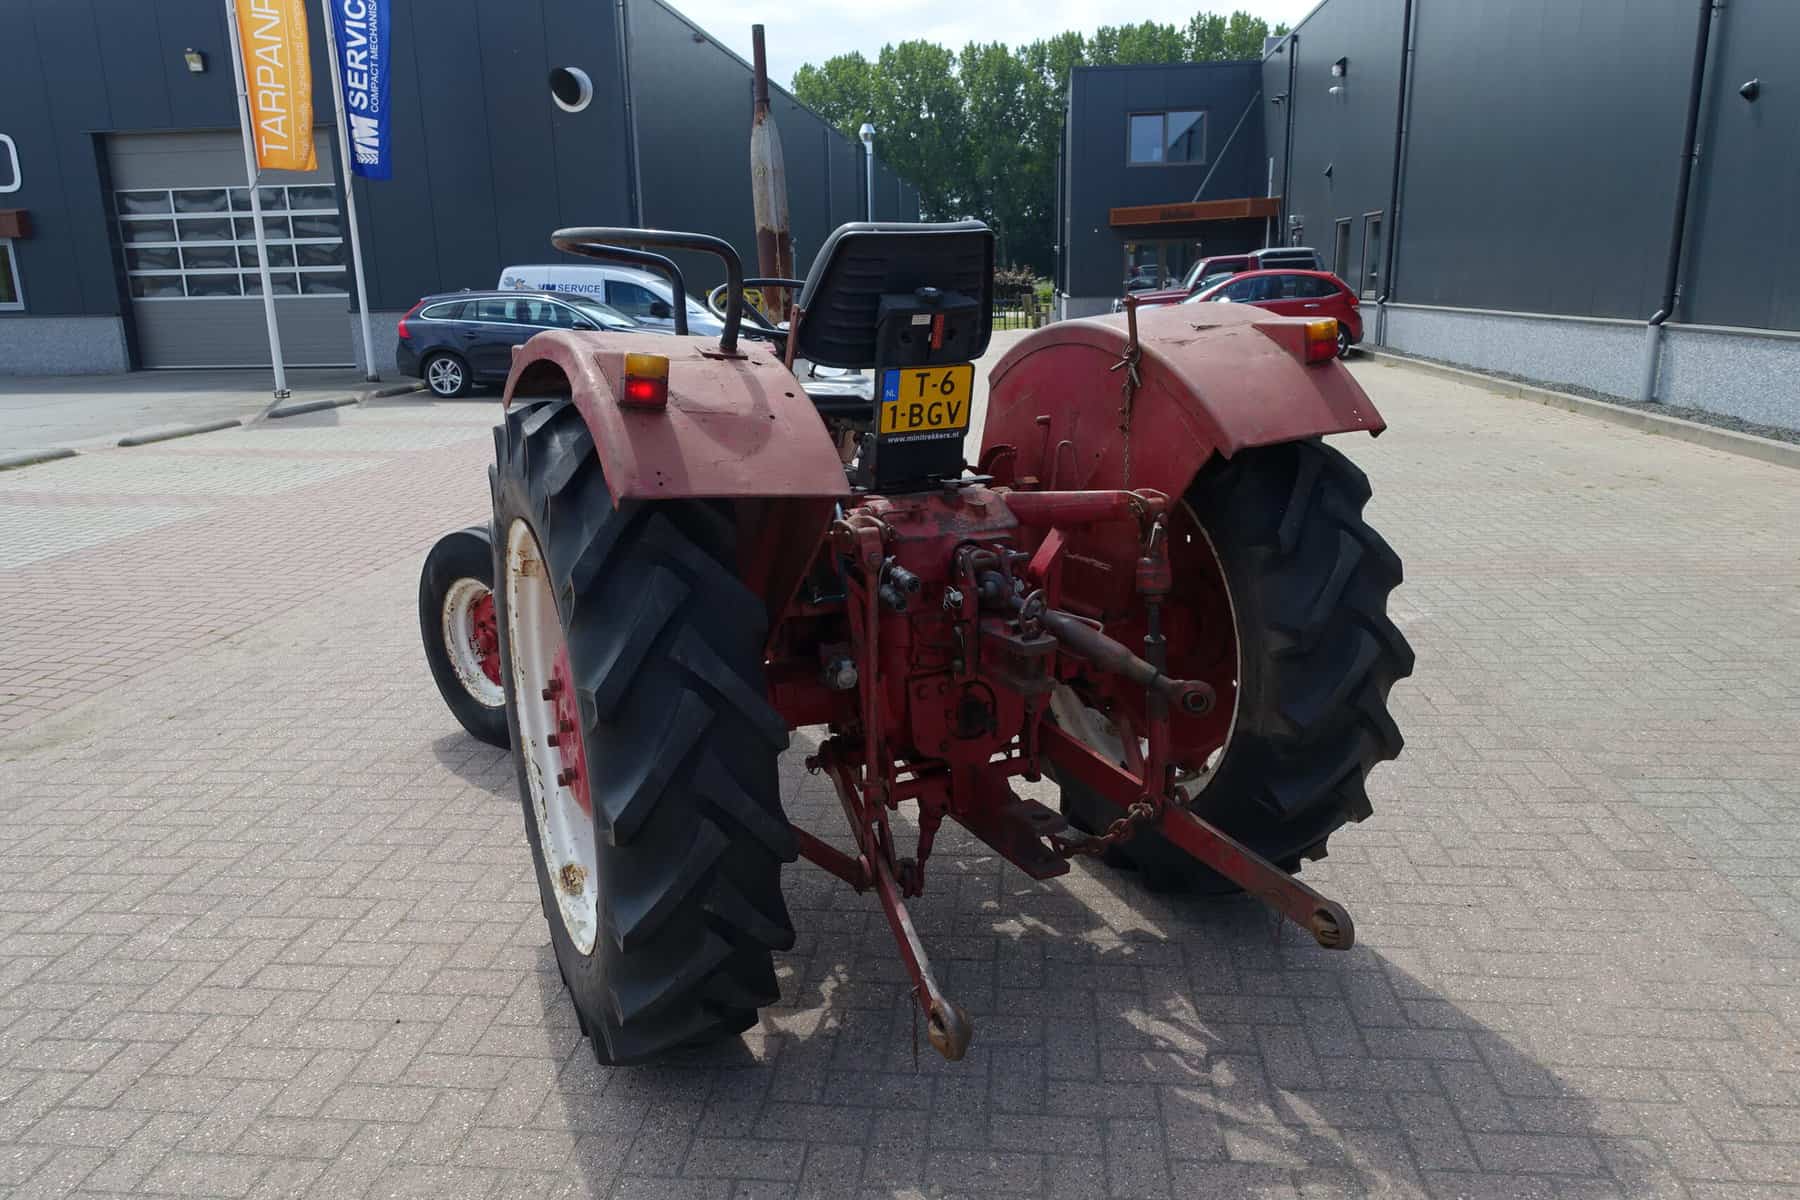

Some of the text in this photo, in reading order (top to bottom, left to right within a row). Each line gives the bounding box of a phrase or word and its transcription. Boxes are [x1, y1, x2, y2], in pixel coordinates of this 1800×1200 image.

[370, 63, 380, 113] COMPACT
[557, 283, 601, 293] SERVICE
[915, 370, 955, 397] T-6
[885, 389, 896, 398] NL
[889, 401, 962, 429] 1-BGV
[887, 432, 960, 443] www.minitrekkers.nl
